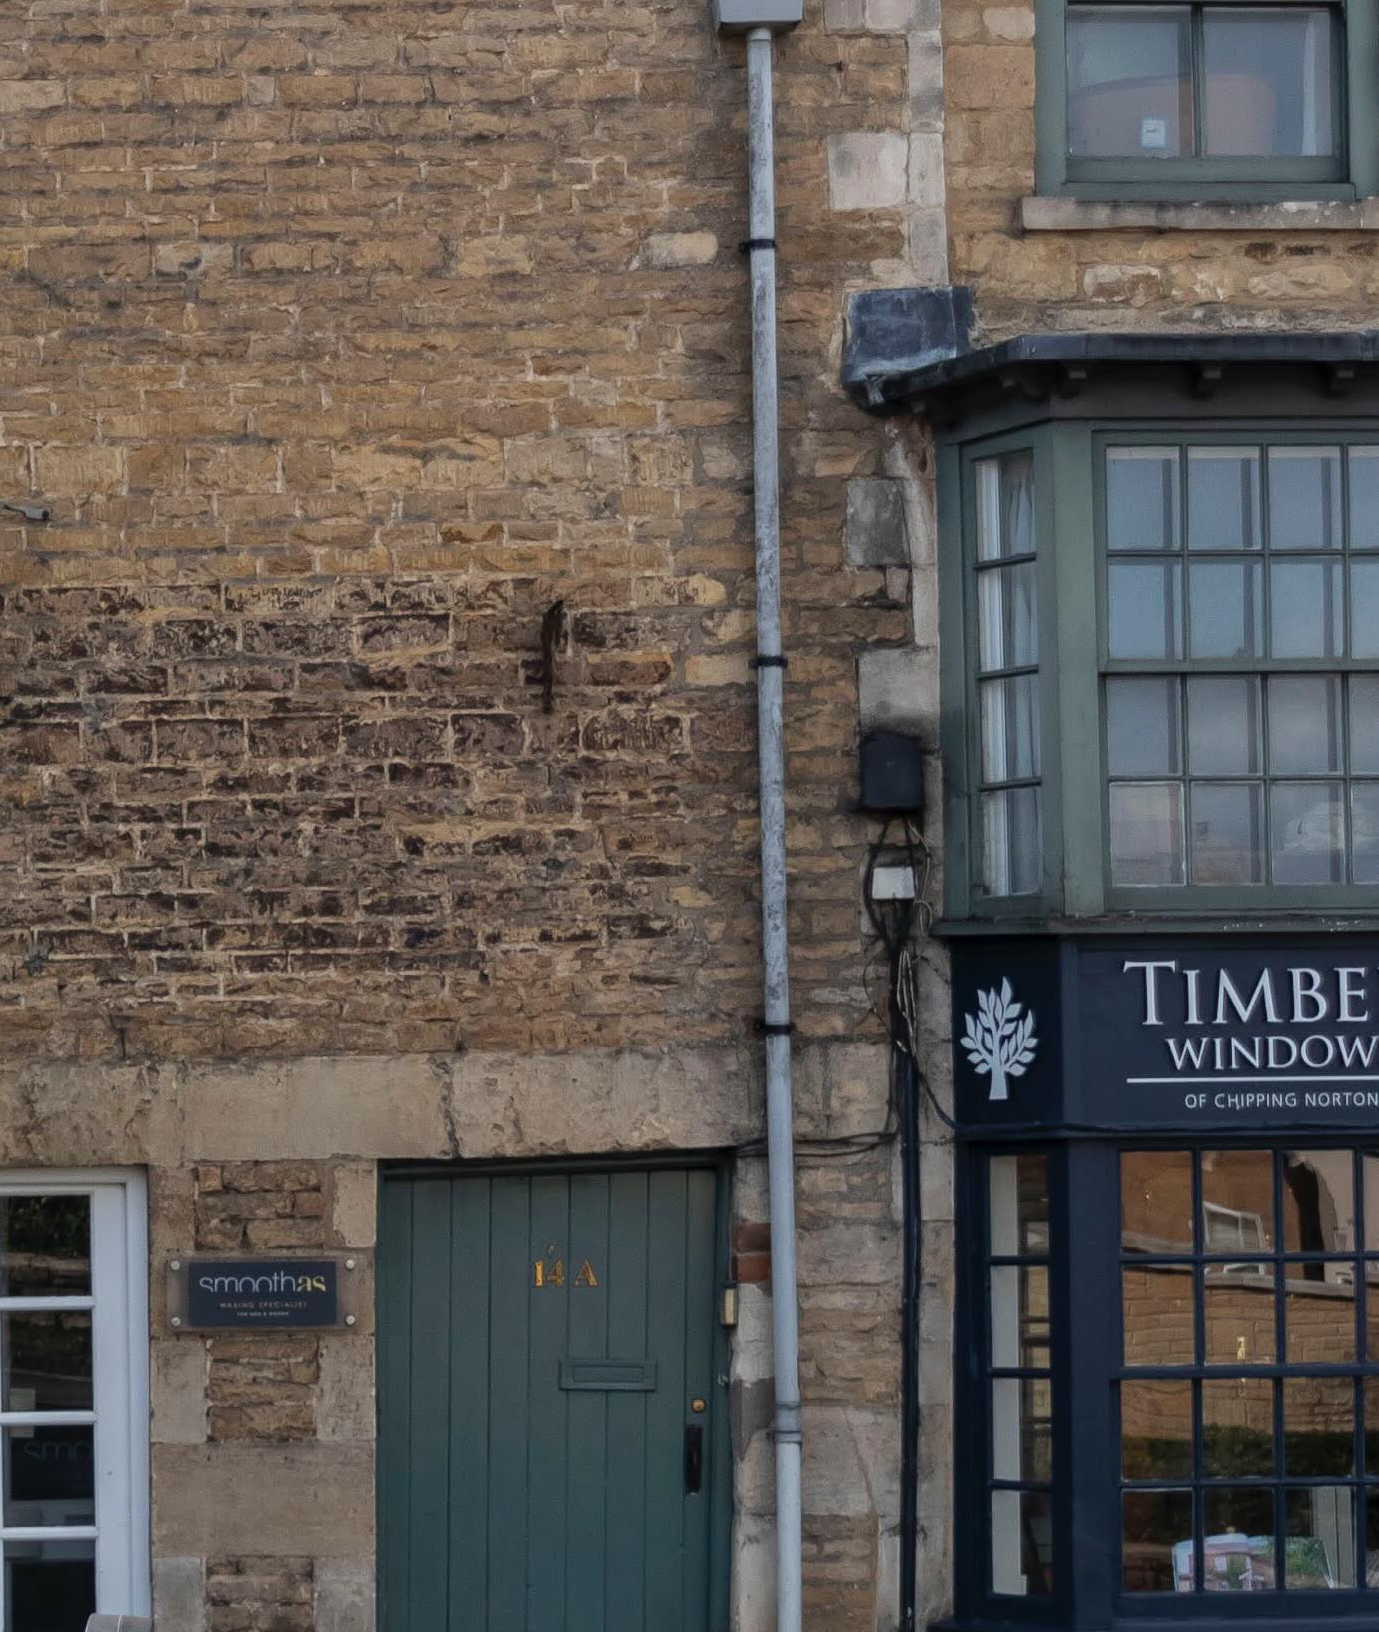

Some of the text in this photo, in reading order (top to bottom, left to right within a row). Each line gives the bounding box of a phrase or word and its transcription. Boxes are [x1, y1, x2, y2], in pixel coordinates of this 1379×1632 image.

[1123, 960, 1379, 1026] TIMBE
[1184, 1092, 1379, 1109] OF CHIPPING NORTON
